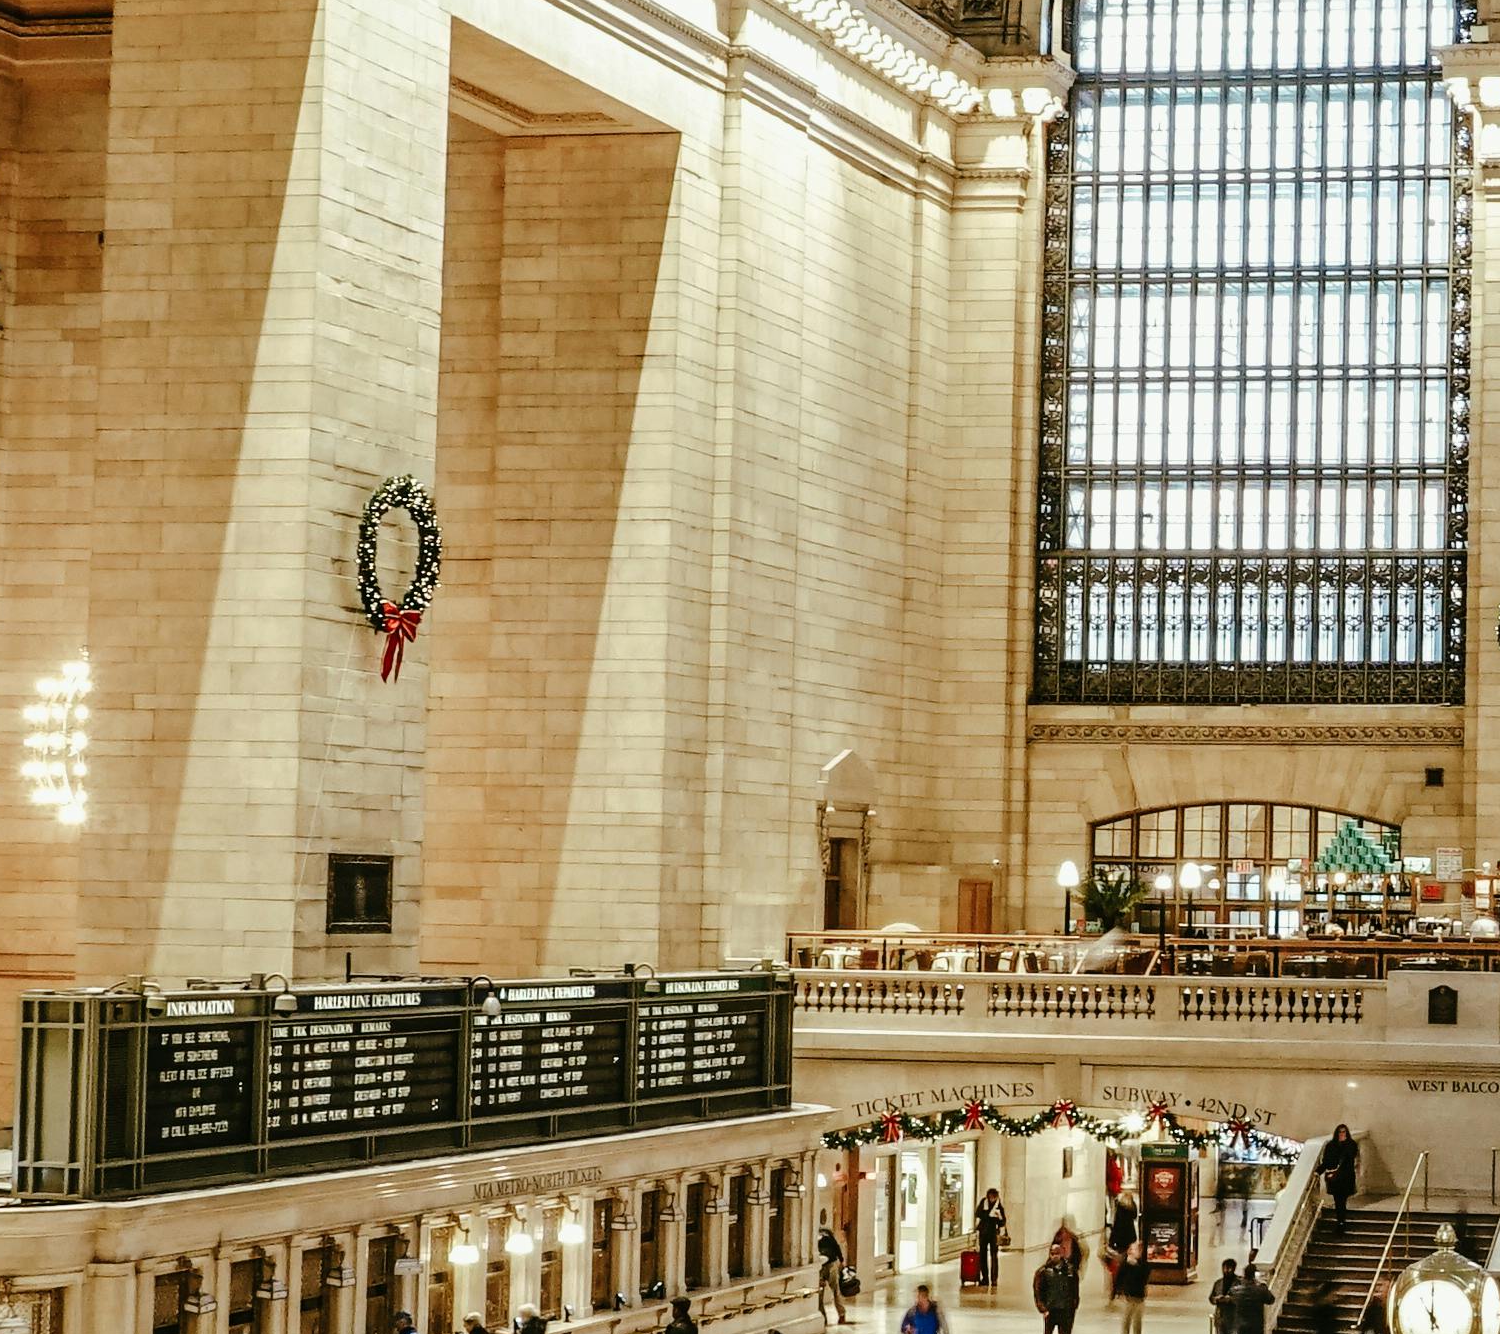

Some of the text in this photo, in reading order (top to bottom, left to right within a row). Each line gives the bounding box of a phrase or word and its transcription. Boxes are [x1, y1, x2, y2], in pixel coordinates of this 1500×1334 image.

[167, 1000, 235, 1017] INFORMATION
[314, 992, 421, 1010] HARLEM LINE DEPARTURES
[272, 1027, 289, 1038] TIME
[310, 1023, 354, 1036] DESTINATION
[1407, 1079, 1449, 1093] WEST
[852, 1082, 1035, 1117] TICKET MACHINES
[1103, 1086, 1277, 1127] SUBWAY 42ND ST
[473, 1166, 603, 1200] MTA METRO-NORTH TICKETS
